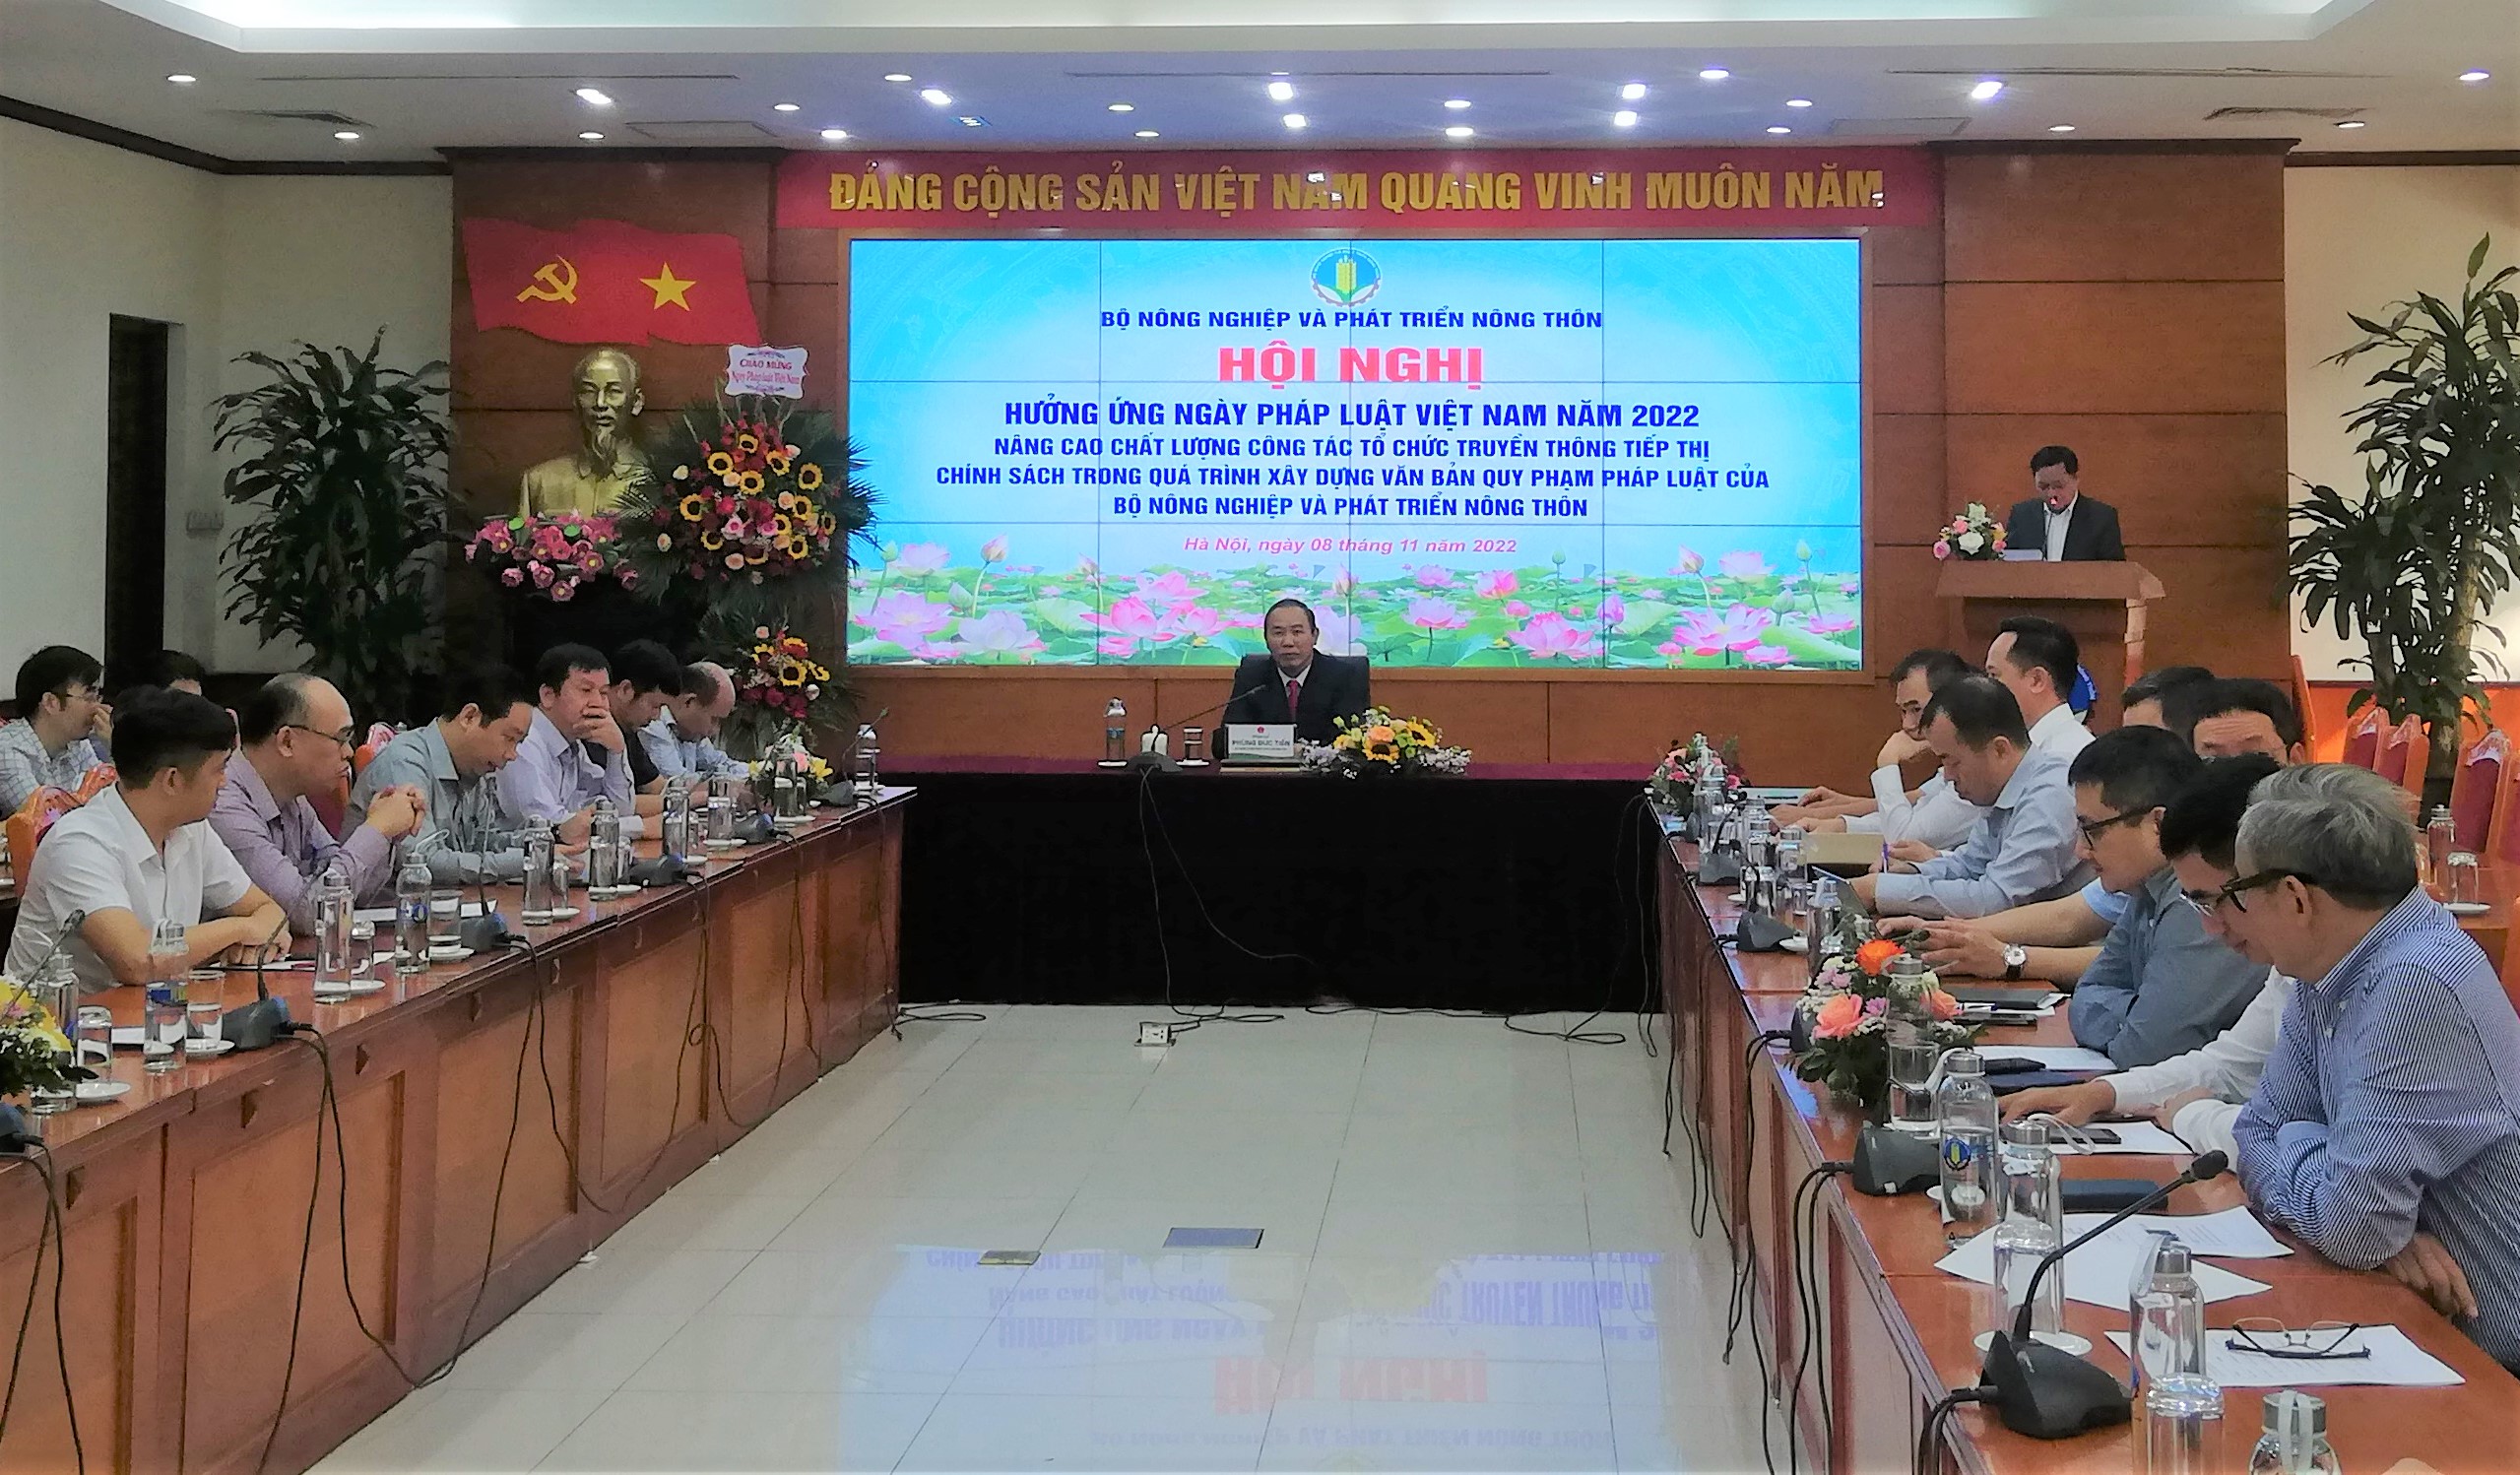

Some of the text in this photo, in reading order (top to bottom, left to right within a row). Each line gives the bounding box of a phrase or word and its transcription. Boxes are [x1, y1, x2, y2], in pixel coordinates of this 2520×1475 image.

[829, 159, 941, 212] ĐẢNG
[953, 164, 1064, 218] CỘNG
[1075, 160, 1160, 211] SẢN
[1177, 164, 1260, 218] VIỆT
[1273, 172, 1367, 210] NAM
[1381, 171, 1521, 214] QUANG
[1534, 172, 1632, 210] VINH
[1646, 162, 1771, 210] MUÔN
[1101, 305, 1602, 332] BỘ NÔNG NGHIỆP VÀ PHÁT TRIỂN NÔNG THÔN
[1218, 339, 1483, 391] HỘI NGHỊ
[1005, 394, 1700, 432] HƯỞNG ỨNG NGÀY PHÁP LUẬT VIỆT NAM NĂM 2022
[995, 431, 1710, 463] NÂNG CAO CHẤT LƯỢNG CÔNG TÁC TỔ CHỨC TRUYỀN THÔNG TIẾP THỊ
[937, 462, 1770, 491] CHÍNH SÁCH TRONG QUÁ TRÌNH XÂY DỰNG VĂN BẢN QUY PHẠM PHÁP LUẬT CỦA
[1114, 491, 1587, 519] BỘ NÔNG NGHIỆP VÀ PHÁT TRIỂN NÔNG THÔN
[1185, 537, 1517, 554] Hà Nội, ngày 08 tháng 11 năm 2022
